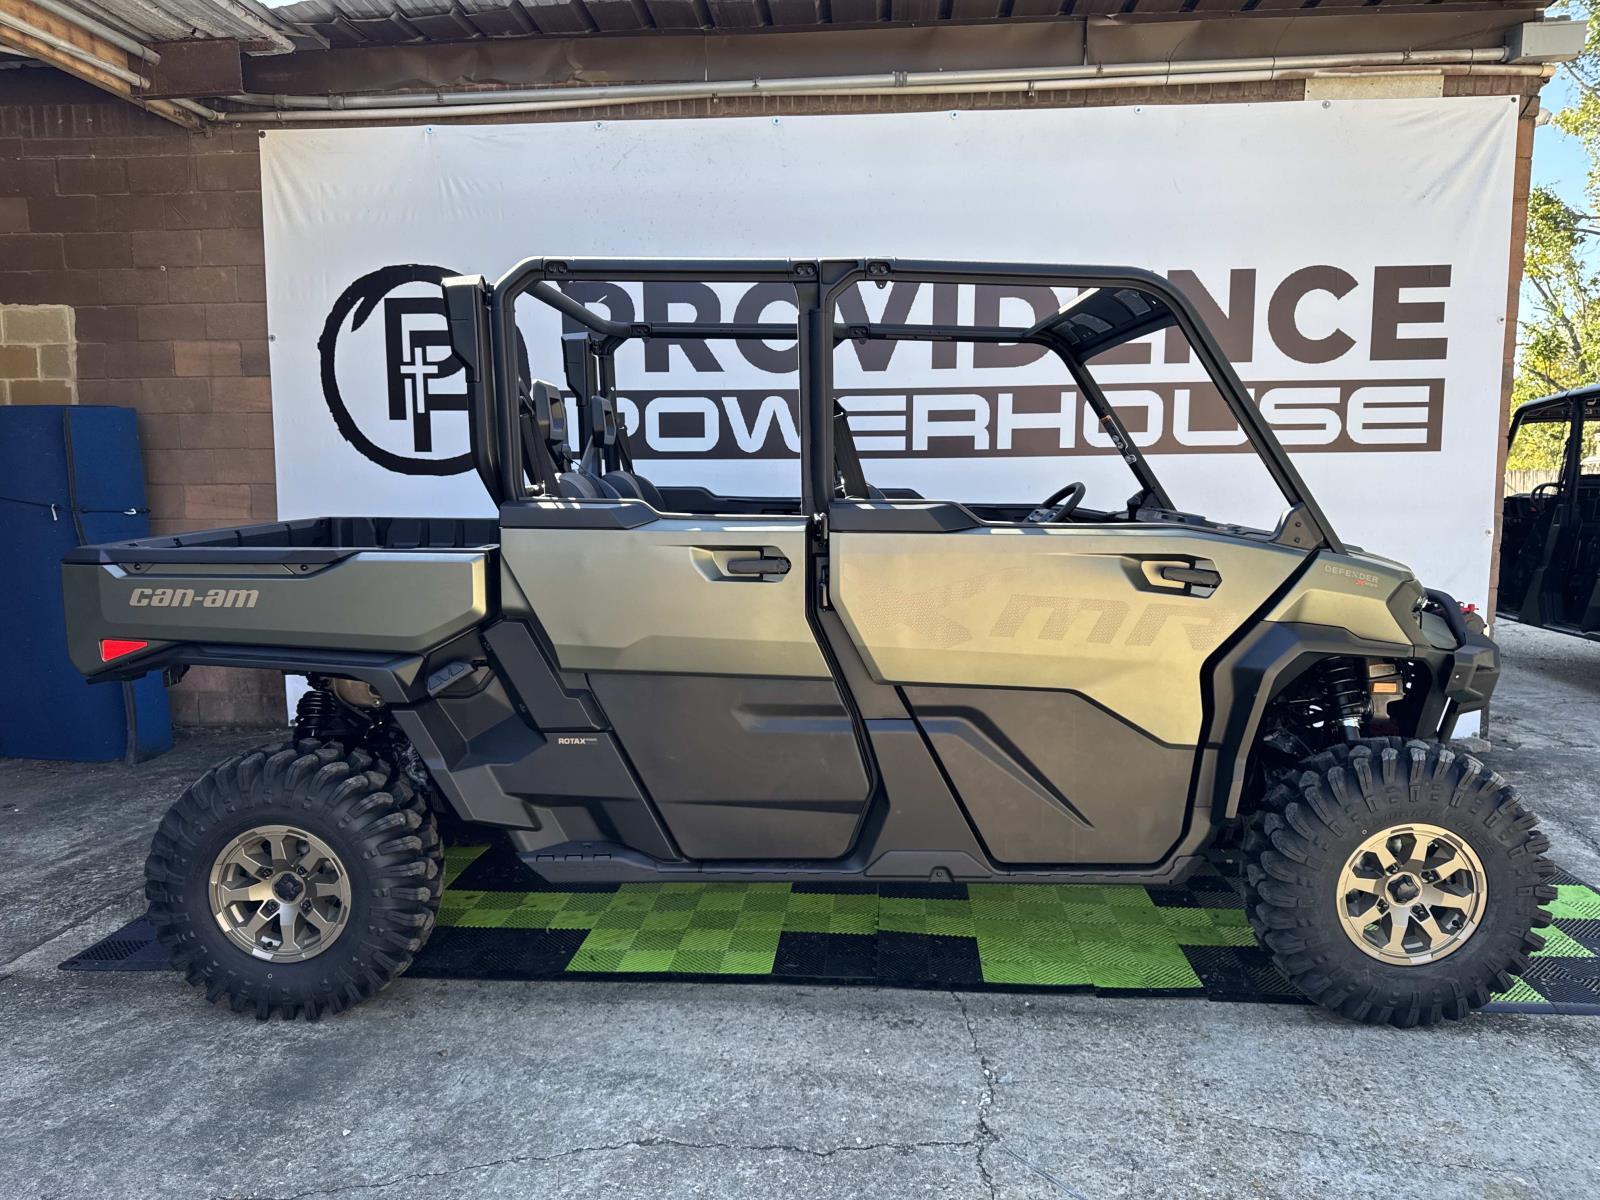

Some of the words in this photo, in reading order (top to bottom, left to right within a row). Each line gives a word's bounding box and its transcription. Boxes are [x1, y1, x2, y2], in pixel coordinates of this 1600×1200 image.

[560, 264, 1452, 374] PROVIDNCE
[1324, 564, 1379, 583] DEFENDER
[128, 588, 260, 608] can-am
